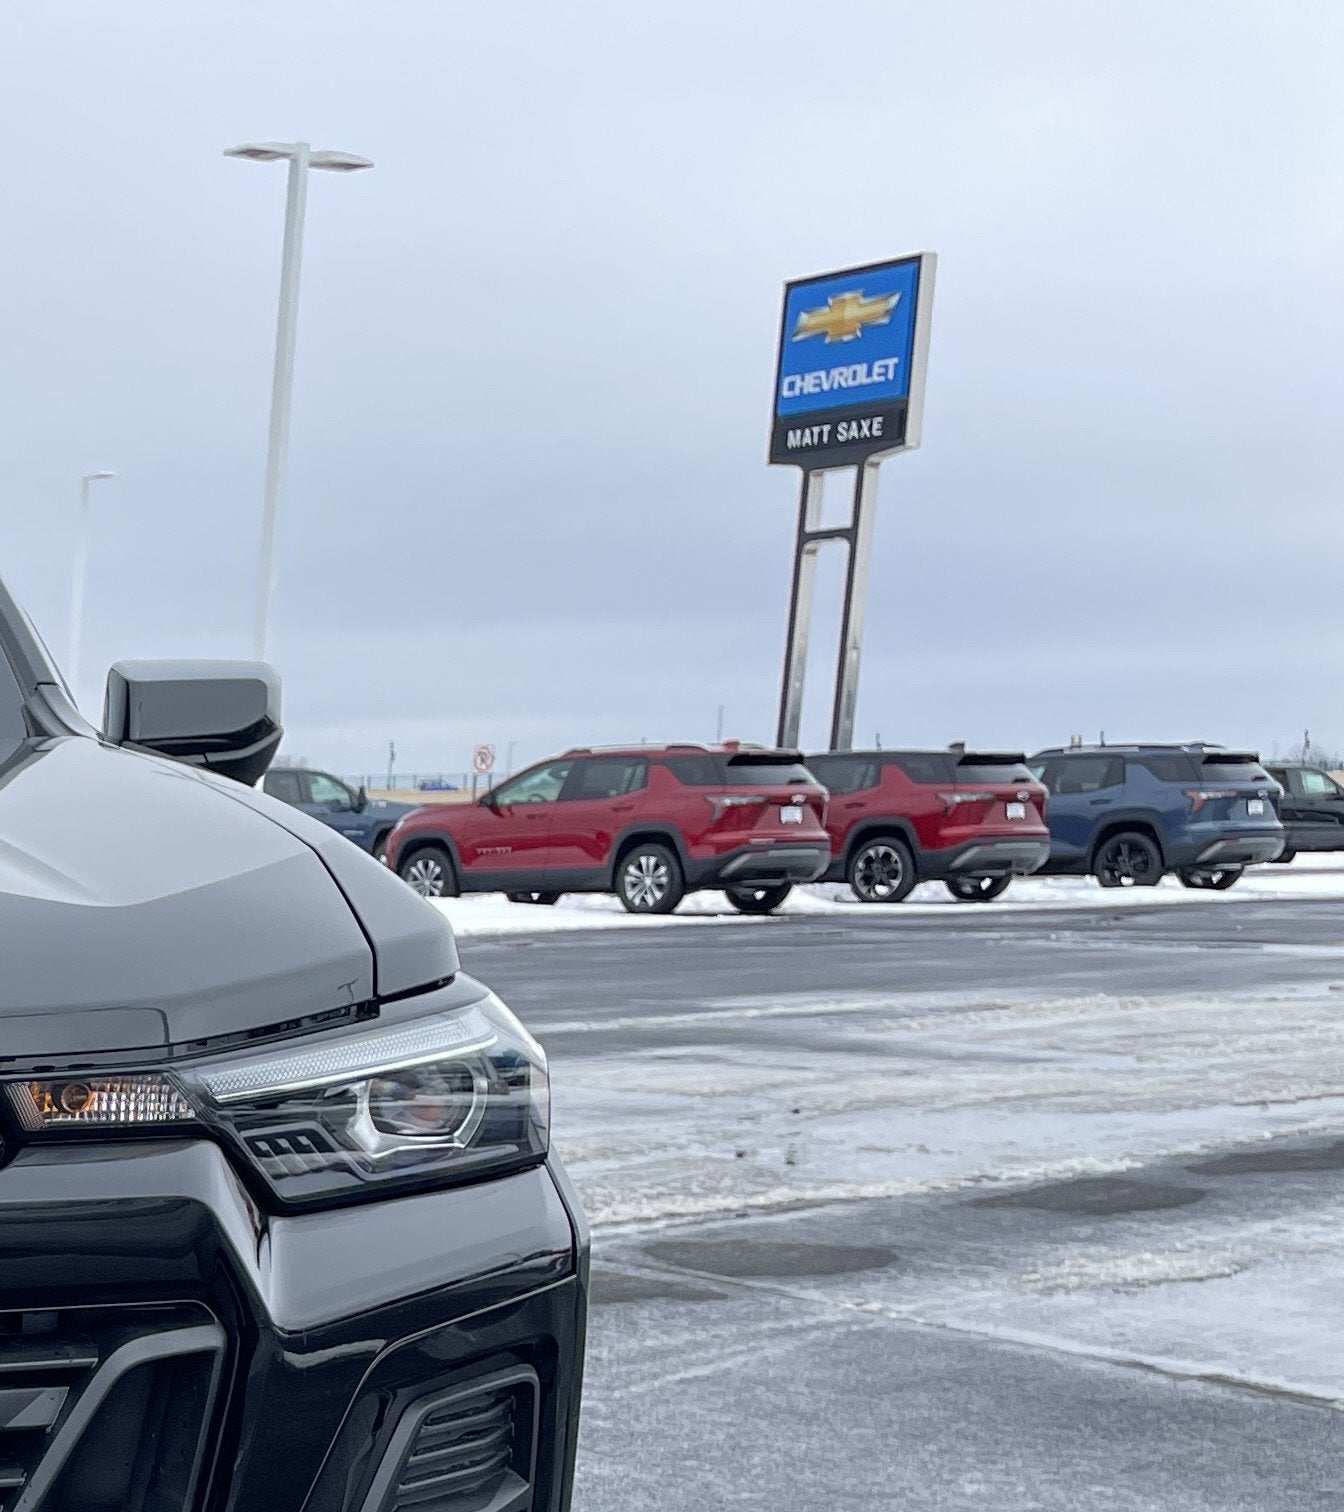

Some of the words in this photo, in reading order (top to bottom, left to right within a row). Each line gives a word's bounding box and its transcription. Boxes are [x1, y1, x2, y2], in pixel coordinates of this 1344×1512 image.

[782, 357, 900, 399] CHEVROLET
[786, 423, 832, 449] MATT
[836, 416, 884, 442] SAXE
